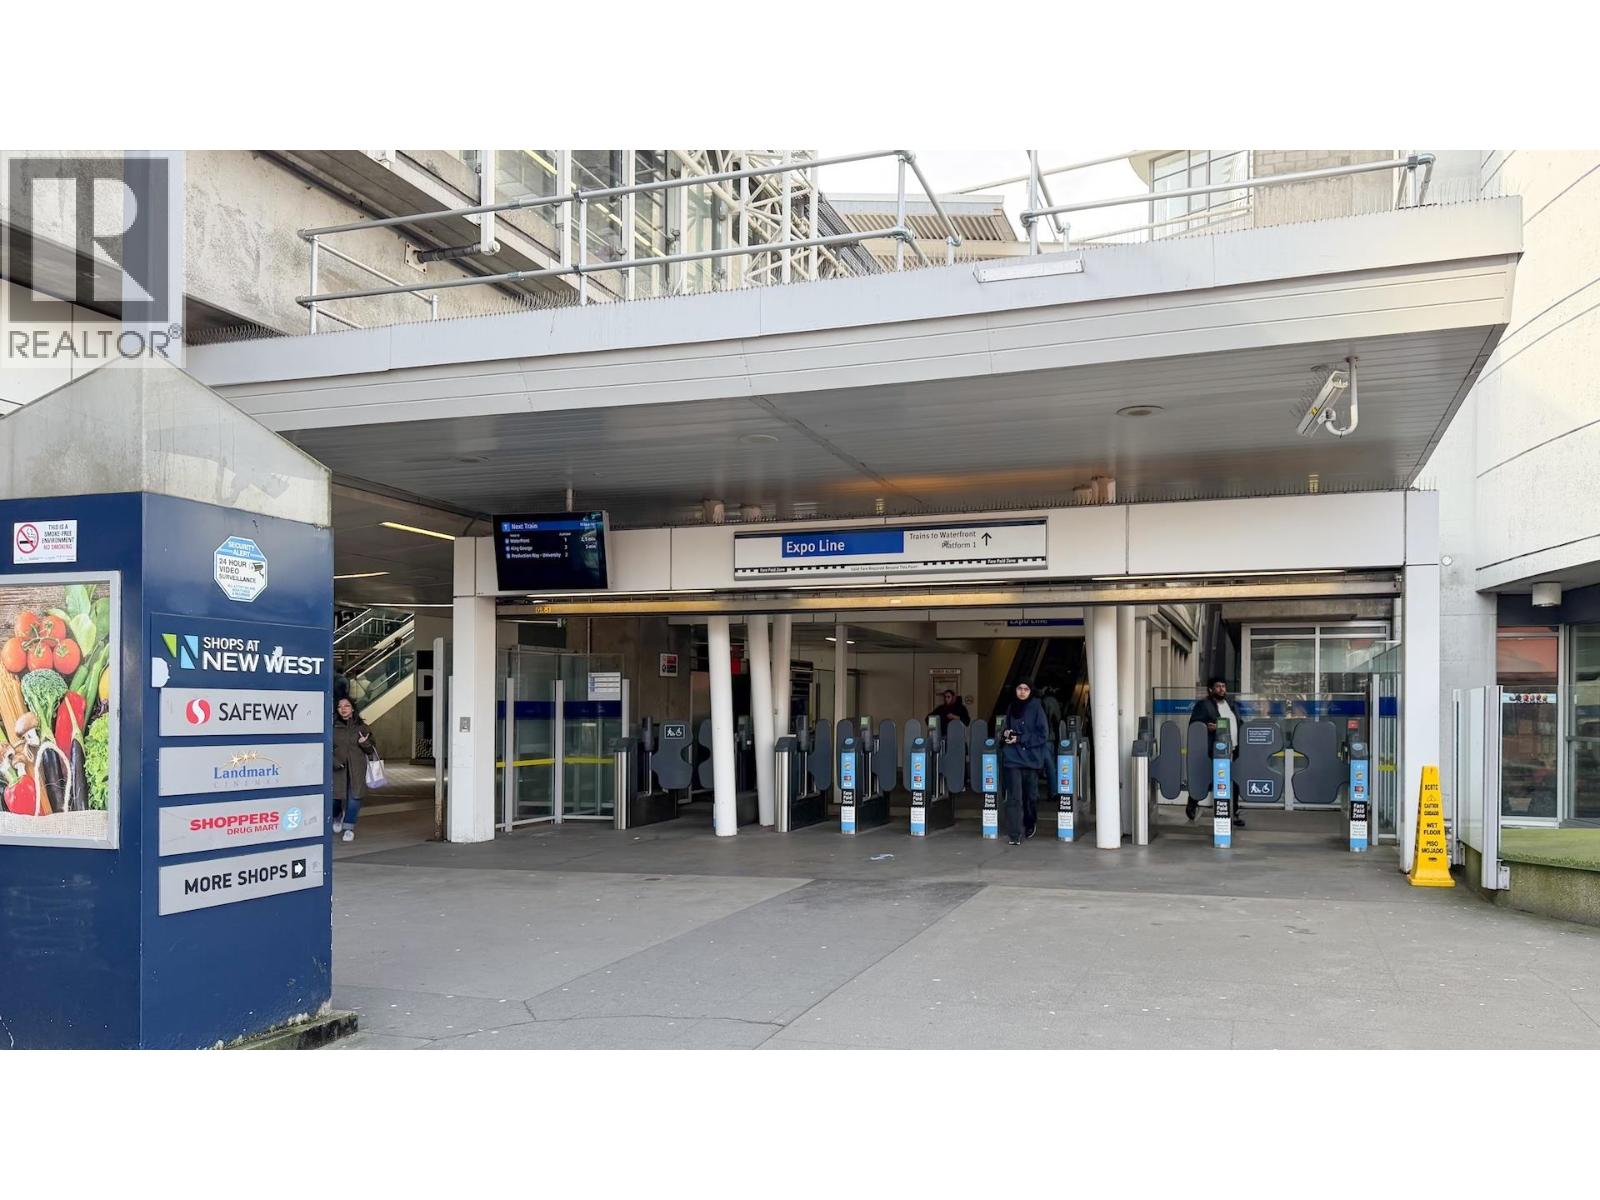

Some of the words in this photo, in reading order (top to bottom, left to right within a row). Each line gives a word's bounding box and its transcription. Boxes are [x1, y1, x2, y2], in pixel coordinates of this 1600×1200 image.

[786, 541, 816, 555] Expo
[818, 540, 845, 552] Line
[219, 566, 240, 574] VIDEO
[219, 573, 256, 583] SURVEILLANCE
[203, 636, 244, 651] SHOPS
[246, 639, 260, 651] AT
[202, 651, 259, 673] NEW
[264, 654, 324, 676] WEST
[218, 702, 298, 721] SAFEWAY
[214, 764, 280, 780] Landmark
[190, 811, 280, 831] SHOPPERS
[226, 824, 253, 836] DRUG
[254, 822, 279, 833] MART
[184, 872, 232, 895] MORE
[238, 864, 288, 886] SHOPS
